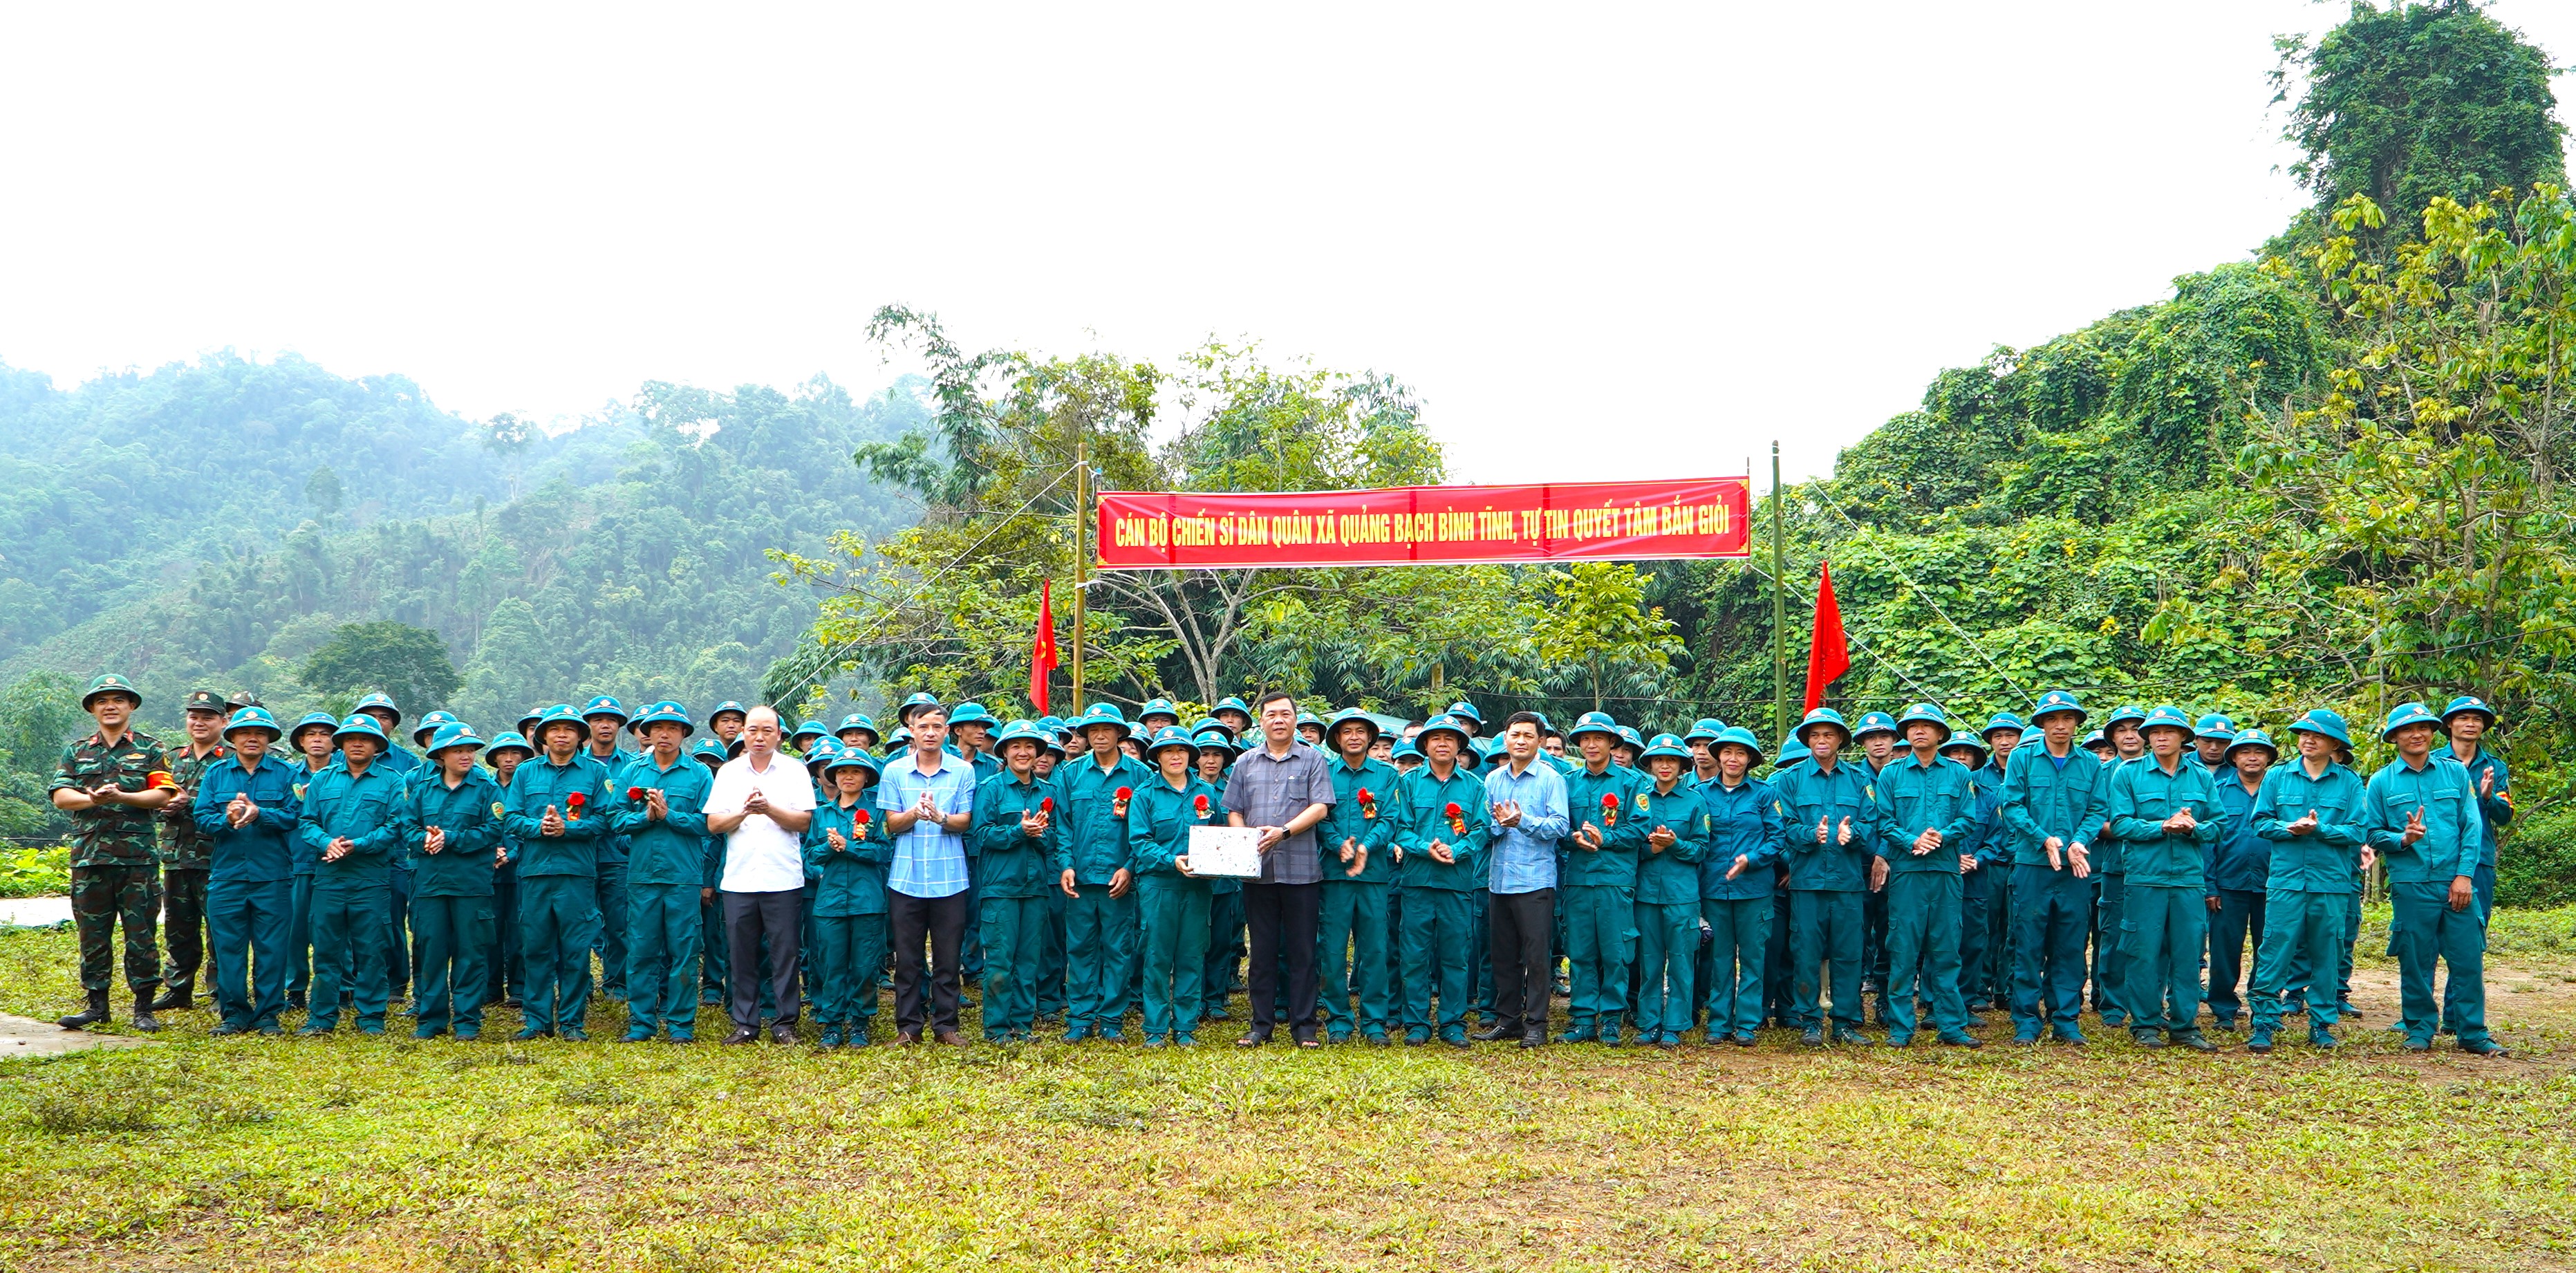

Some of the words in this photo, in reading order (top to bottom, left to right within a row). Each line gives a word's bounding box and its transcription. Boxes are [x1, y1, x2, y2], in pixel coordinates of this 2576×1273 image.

[1116, 512, 1145, 547] CÁN
[1149, 514, 1168, 552] BỘ
[1172, 508, 1215, 546] CHIẾN
[1220, 512, 1233, 546] SĨ
[1238, 510, 1267, 545] DÂN
[1272, 510, 1312, 548] QUÂN
[1316, 510, 1336, 544] XÃ
[1340, 504, 1390, 546] QUẢNG
[1394, 513, 1434, 549] BẠCH
[1439, 506, 1474, 541] BÌNH
[1478, 506, 1517, 543] TĨNH,
[1522, 508, 1541, 546] TỰ
[1544, 509, 1568, 539] TIN
[1574, 499, 1619, 541] QUYẾT
[1625, 501, 1657, 537] TÂM
[1662, 495, 1693, 536] BẮN
[1699, 494, 1729, 535] GIỎI
